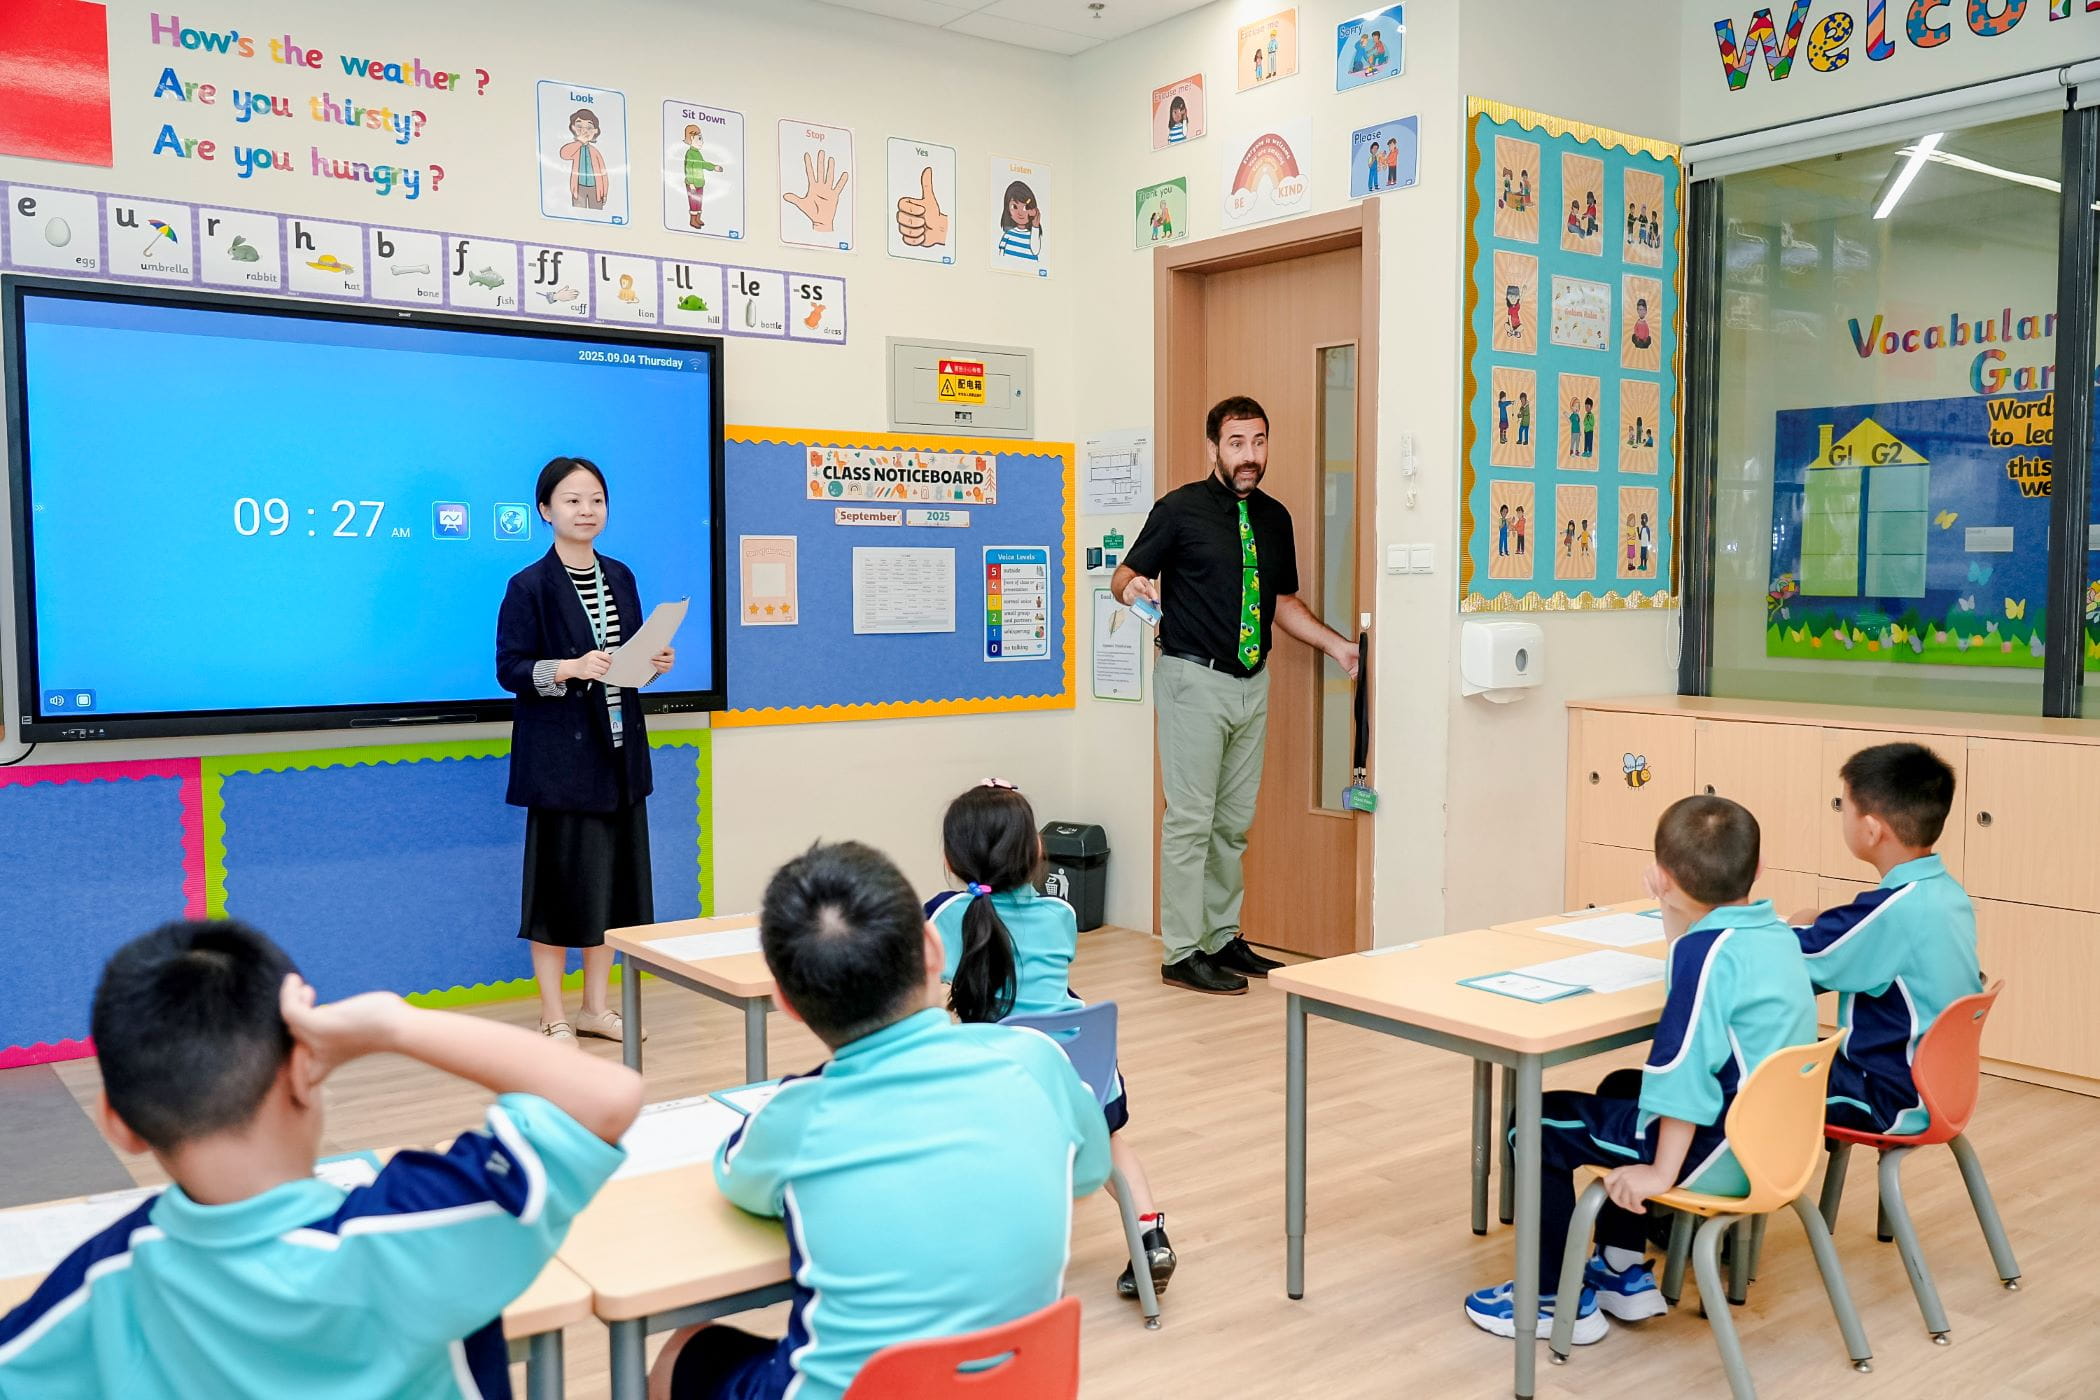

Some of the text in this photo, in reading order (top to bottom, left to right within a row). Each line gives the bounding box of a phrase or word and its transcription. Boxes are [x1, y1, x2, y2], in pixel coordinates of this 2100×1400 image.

[1340, 24, 1363, 37] Sorry
[1714, 0, 2100, 91] Welco
[150, 12, 490, 95] How's the weather ?
[570, 92, 594, 103] Look
[154, 67, 427, 144] Are you thirsty?
[682, 109, 726, 125] Sit Down
[806, 129, 825, 140] Stop
[1354, 131, 1381, 144] Please
[915, 148, 929, 157] Yes
[153, 124, 444, 199] Are you hungry ?
[1009, 164, 1032, 174] Listen
[1160, 187, 1173, 198] you
[1278, 183, 1303, 198] KIND
[17, 197, 37, 216] e
[1234, 197, 1245, 209] BE
[115, 207, 139, 228] u
[207, 217, 221, 236] r
[295, 221, 315, 250] h
[377, 231, 395, 258] b
[76, 257, 96, 268] egg
[453, 241, 470, 276] f
[141, 262, 189, 274] umbrella
[601, 256, 610, 281] l
[246, 272, 278, 283] rabbit
[344, 280, 361, 291] hat
[417, 288, 440, 298] bone
[496, 295, 515, 306] fish
[570, 303, 587, 314] cuff
[638, 309, 655, 318] lion
[707, 315, 720, 324] hill
[760, 320, 782, 330] bottle
[824, 327, 842, 335] dress
[1848, 308, 2058, 358] Vocabular
[579, 350, 684, 370] 2025.09.04 Thursday
[1970, 348, 2056, 394] Gar
[957, 378, 982, 390] 配电箱
[1989, 394, 2055, 421] Word
[1990, 423, 2053, 445] to le
[1871, 442, 1903, 465] G2
[2008, 456, 2052, 478] this
[823, 466, 983, 484] CLASS NOTICEBOARD
[2020, 481, 2052, 496] we
[840, 511, 897, 523] September
[926, 511, 950, 521] 2025
[391, 528, 411, 538] AM
[991, 567, 997, 576] 5
[991, 581, 997, 590] 4
[991, 613, 997, 622] 2
[992, 629, 997, 637] 1
[991, 644, 998, 653] 0
